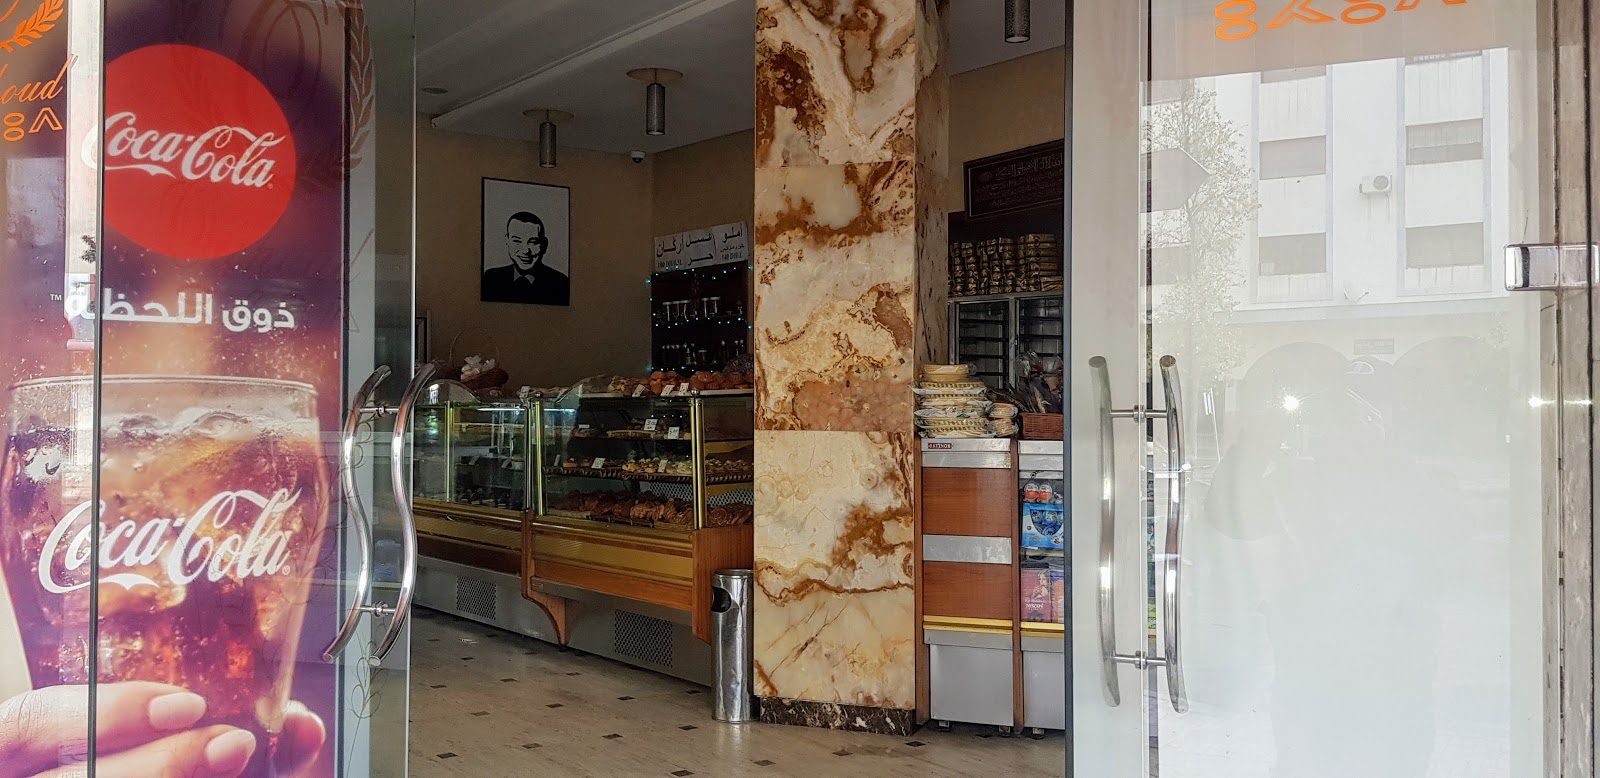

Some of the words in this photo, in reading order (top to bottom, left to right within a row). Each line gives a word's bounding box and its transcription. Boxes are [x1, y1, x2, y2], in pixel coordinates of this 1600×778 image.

[81, 111, 286, 190] Coca-Cola
[65, 287, 213, 325] اللحظة
[222, 300, 295, 333] ذوق
[38, 487, 302, 594] Coca-Cola
